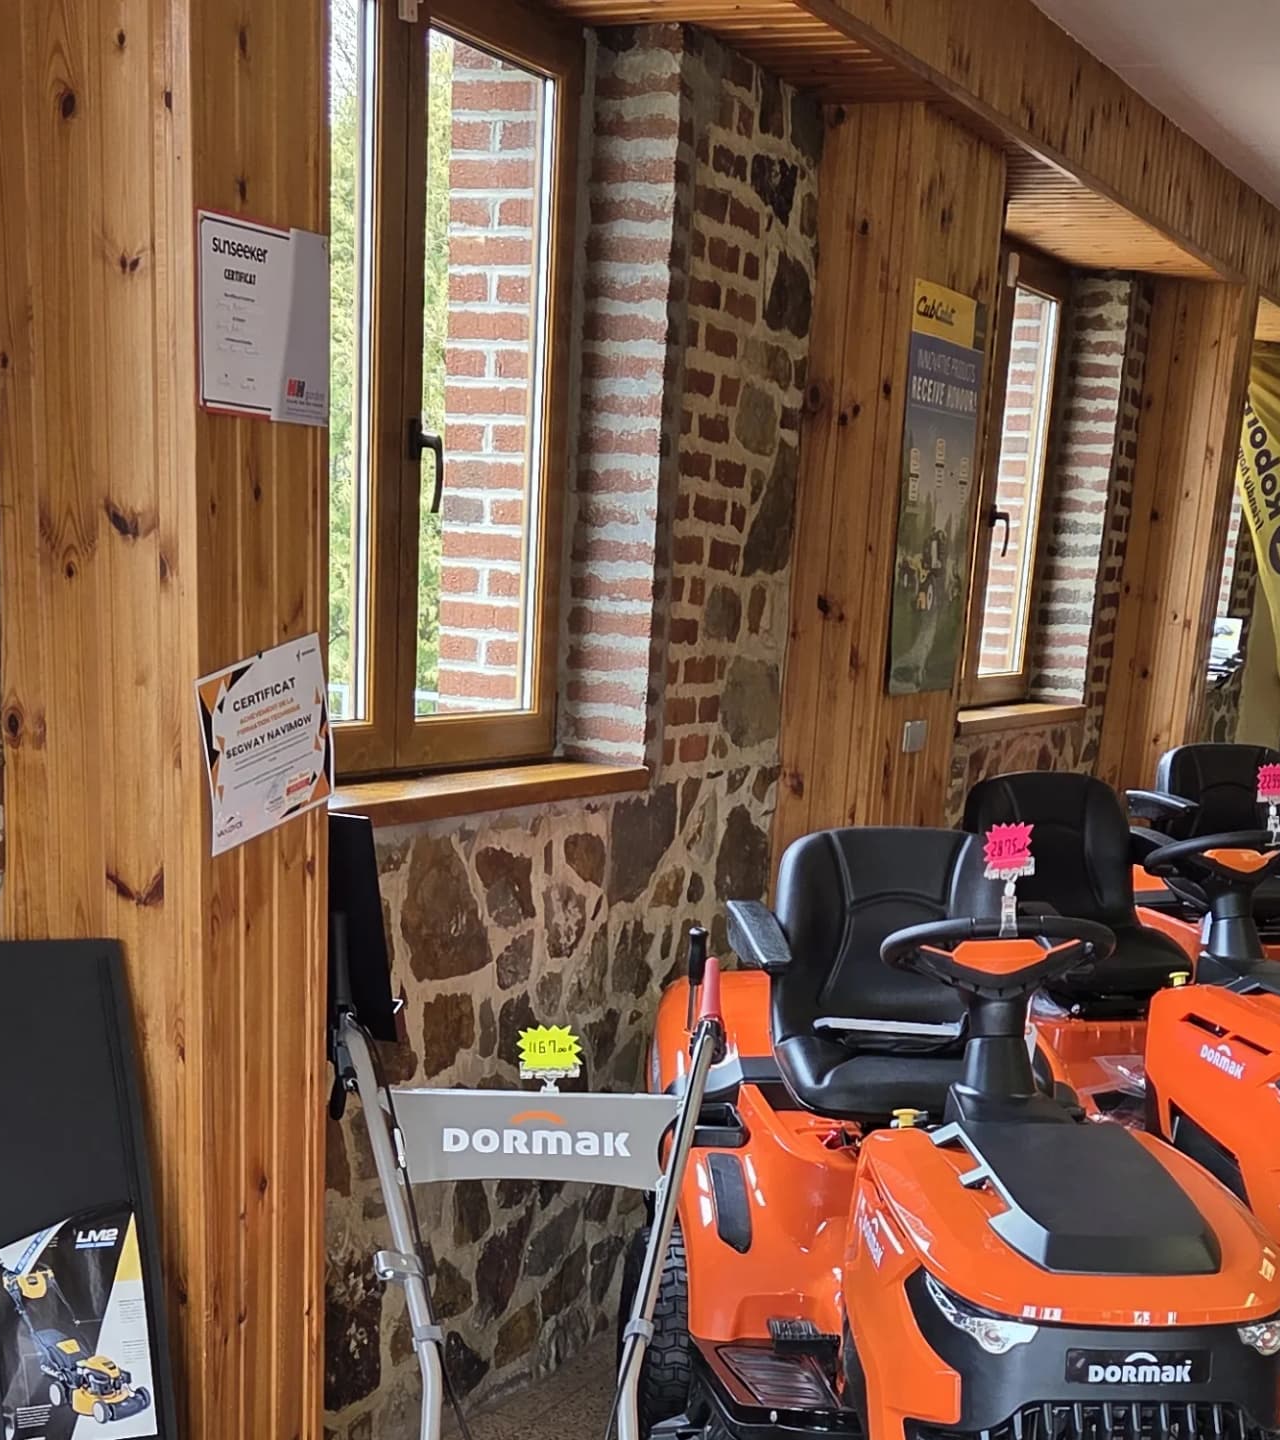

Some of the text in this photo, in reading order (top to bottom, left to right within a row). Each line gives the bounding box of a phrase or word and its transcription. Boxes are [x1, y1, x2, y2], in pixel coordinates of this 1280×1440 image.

[223, 268, 257, 286] CERTIFICAT
[233, 676, 296, 712] CERTIFICAT
[226, 713, 312, 759] SEGWAY NAVIMOW
[75, 1228, 119, 1243] LM2
